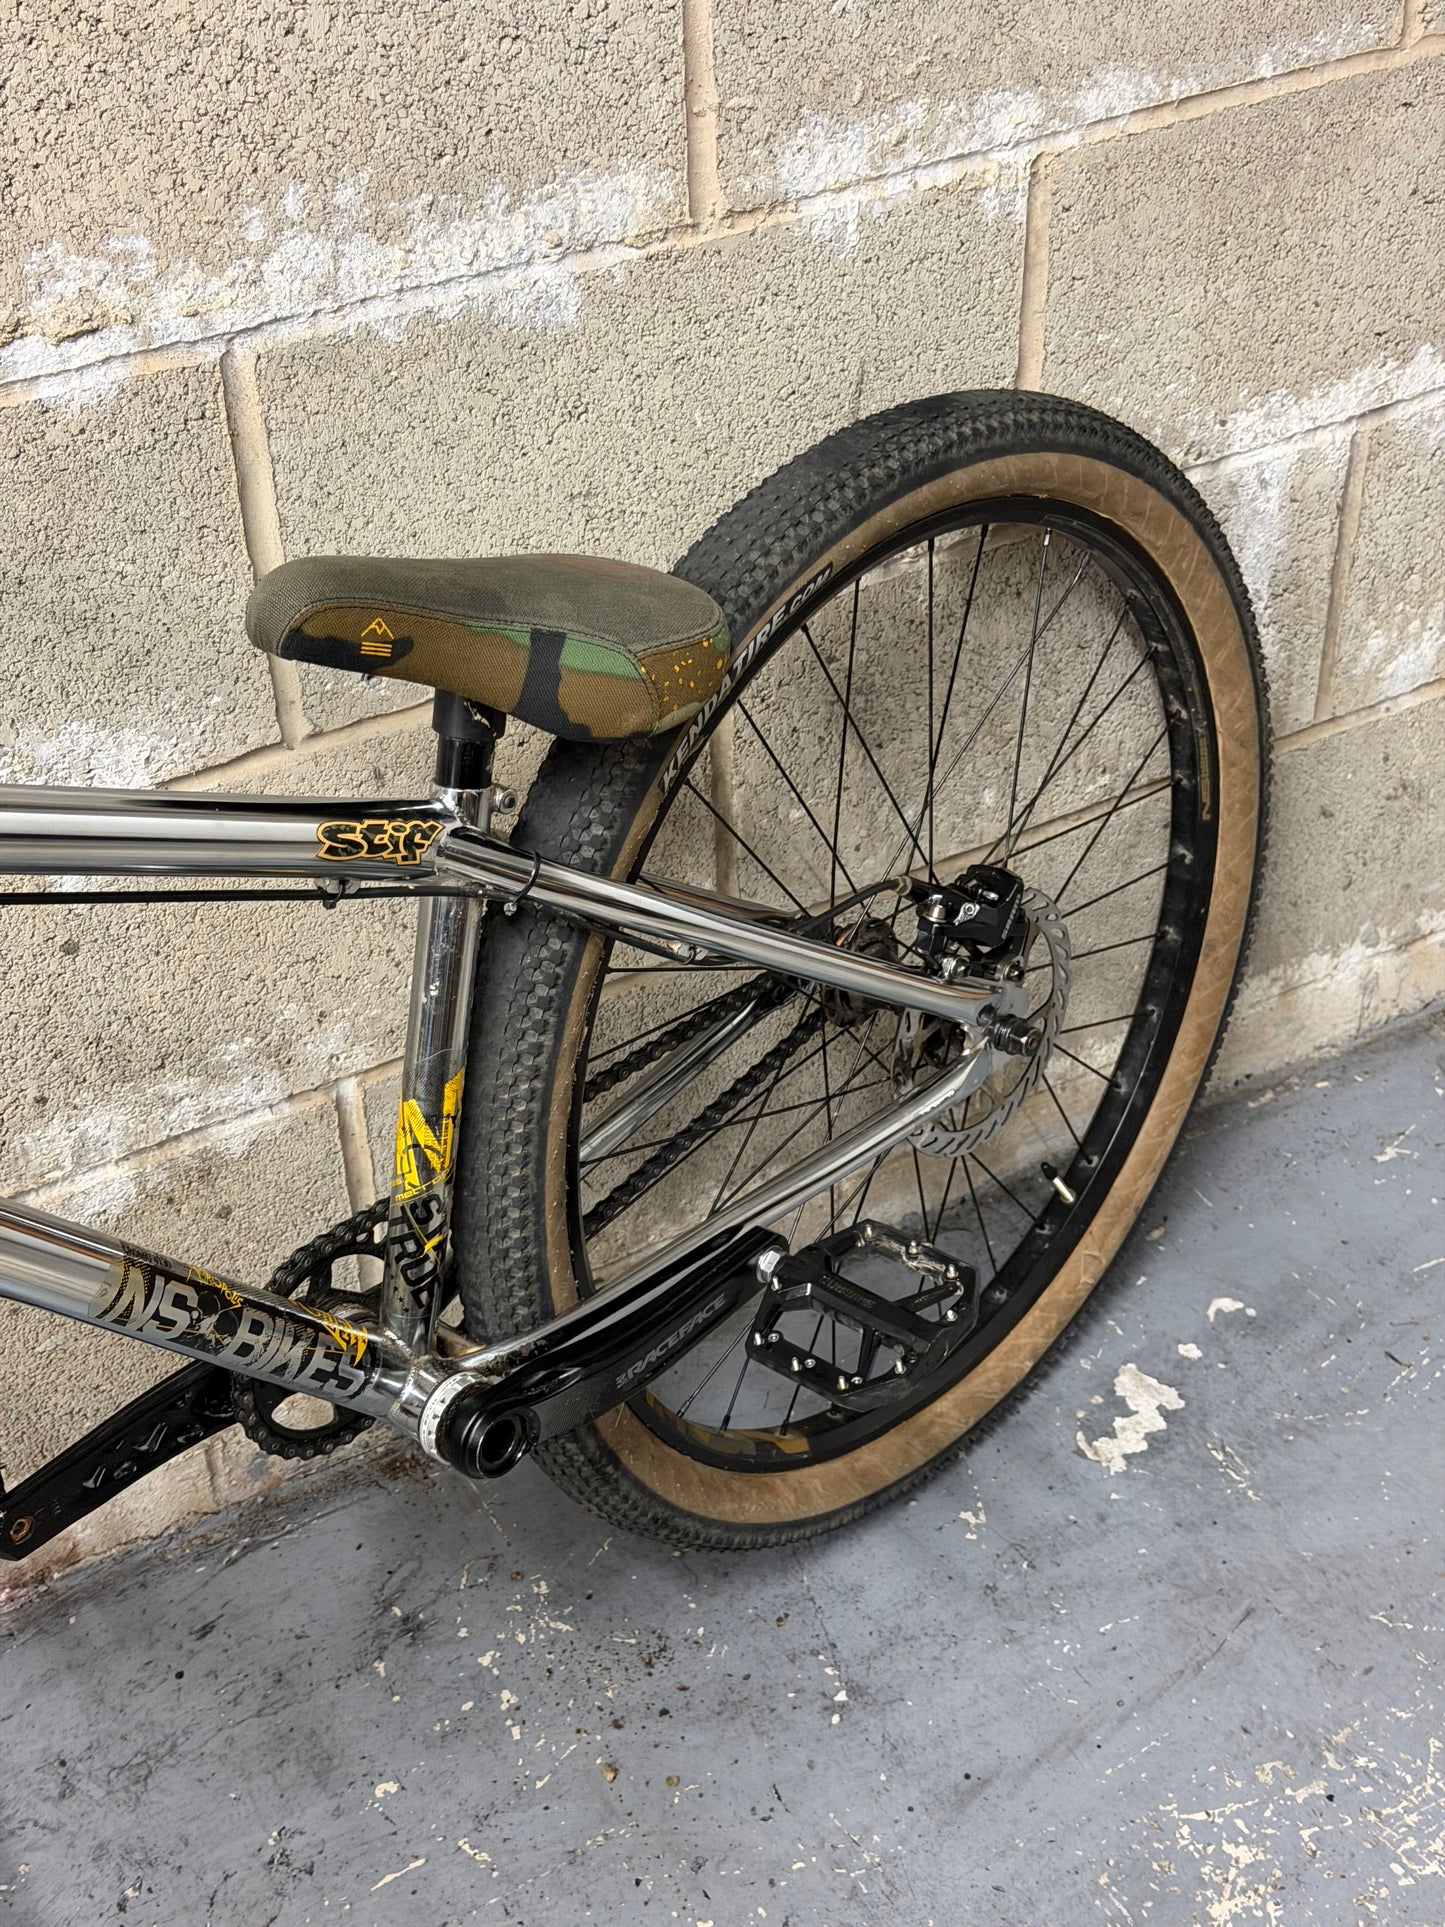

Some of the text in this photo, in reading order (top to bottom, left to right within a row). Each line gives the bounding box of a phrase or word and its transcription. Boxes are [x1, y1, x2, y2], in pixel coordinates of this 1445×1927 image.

[96, 1264, 366, 1399] NS BIKES
[627, 1293, 726, 1379] RACEFACE
